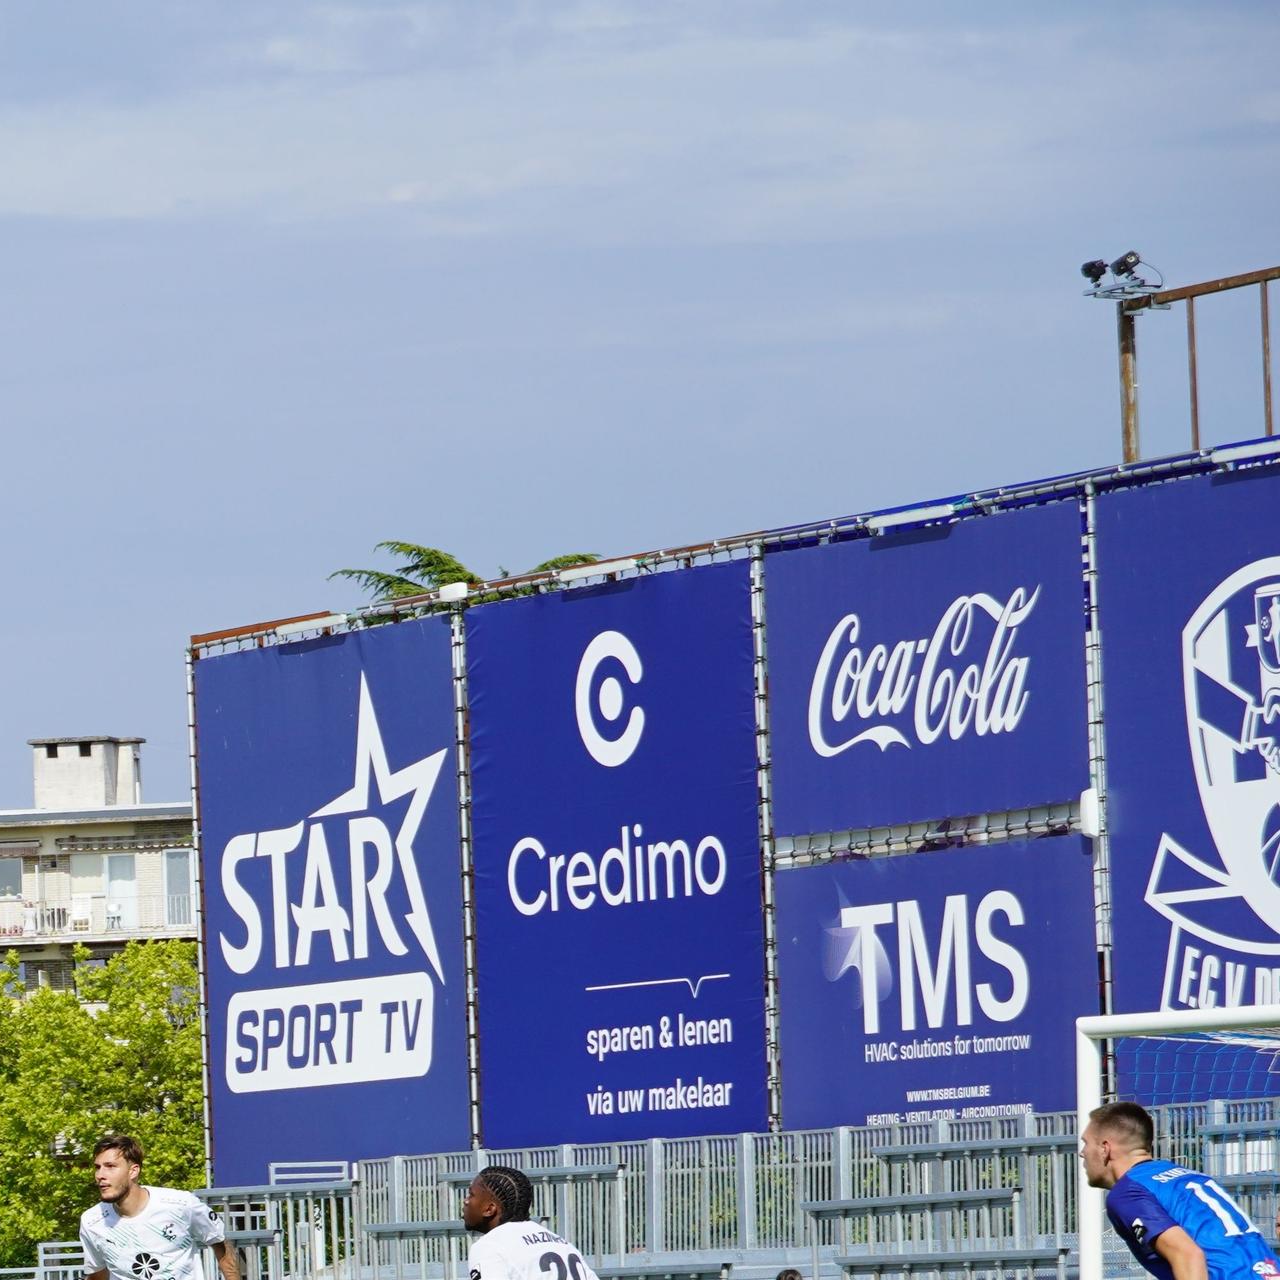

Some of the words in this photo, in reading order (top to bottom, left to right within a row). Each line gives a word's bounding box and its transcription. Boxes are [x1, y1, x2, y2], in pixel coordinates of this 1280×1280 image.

[807, 584, 1041, 758] Coca-Cola
[219, 816, 410, 975] STAR
[507, 823, 727, 916] Credimo
[840, 889, 1030, 1034] TMS
[235, 999, 363, 1075] SPORT
[380, 998, 423, 1054] TV
[586, 1024, 654, 1062] sparen
[659, 1015, 674, 1049] &
[678, 1013, 733, 1047] lenen
[864, 1042, 898, 1063] HVAC
[900, 1038, 952, 1060] solutions
[954, 1035, 971, 1055] for
[973, 1034, 1032, 1053] tomorrow
[586, 1085, 614, 1116] via
[618, 1089, 645, 1114] uw
[648, 1076, 734, 1112] makelaar
[867, 1112, 900, 1126] HEATING
[906, 1108, 955, 1123] VENTILATION
[961, 1103, 1033, 1120] AIRCONDITIONING
[906, 1085, 991, 1103] WWW.TMSBELGIUM.BE
[1185, 1179, 1261, 1237] 11
